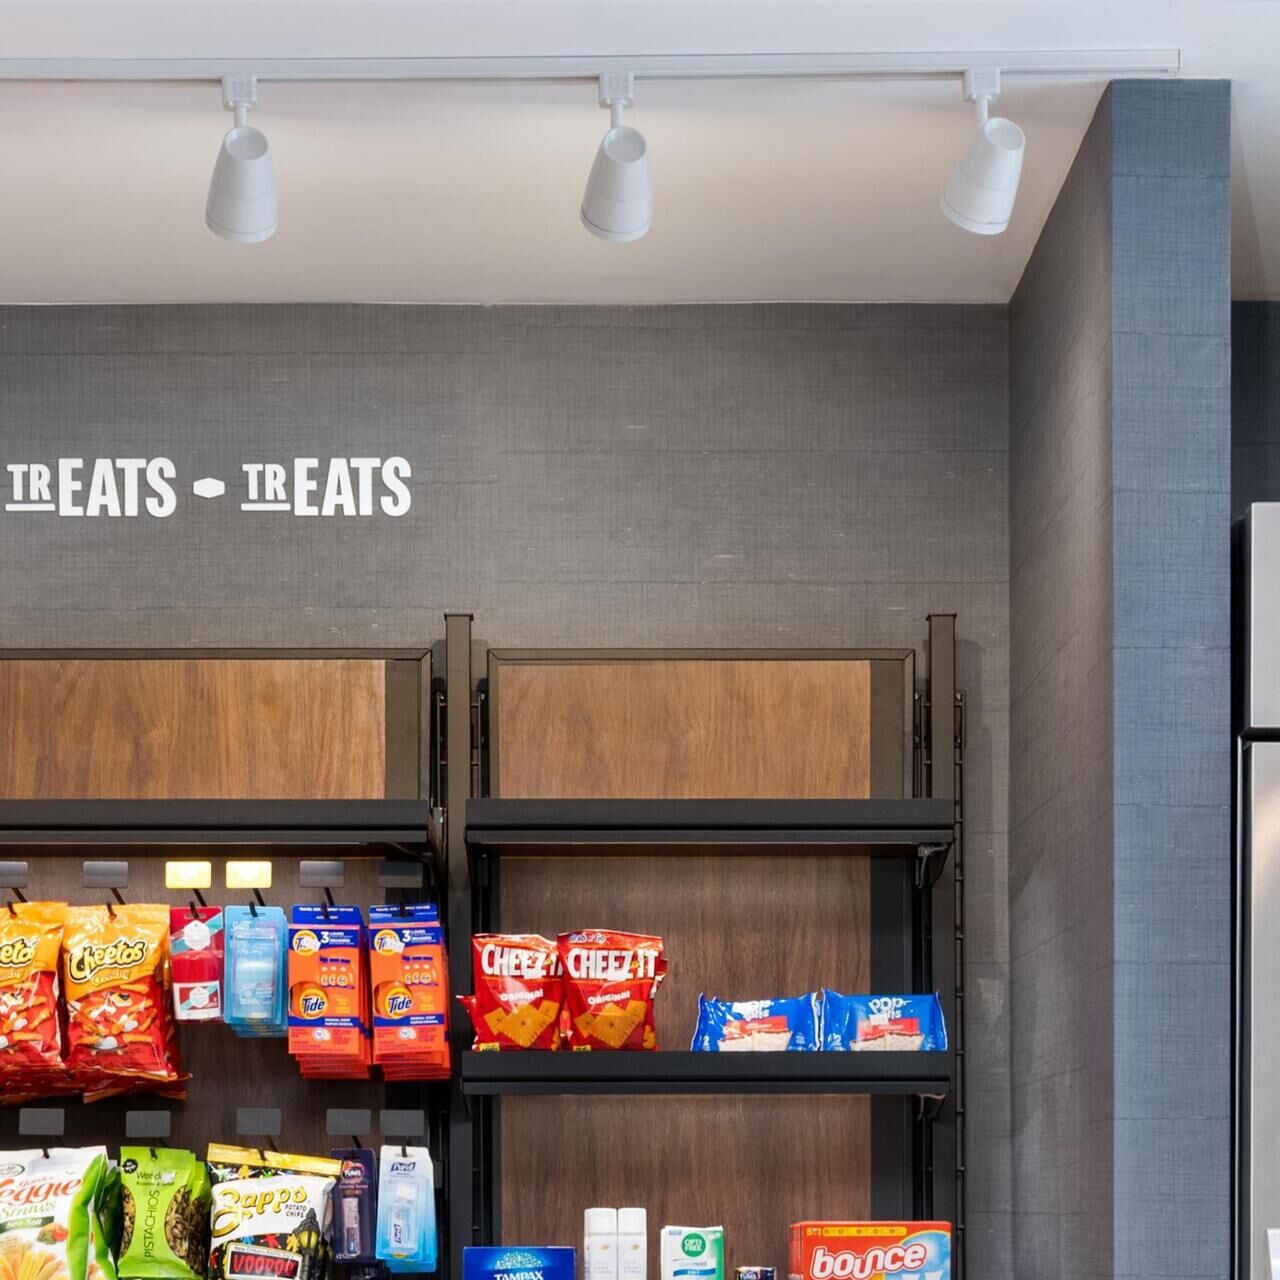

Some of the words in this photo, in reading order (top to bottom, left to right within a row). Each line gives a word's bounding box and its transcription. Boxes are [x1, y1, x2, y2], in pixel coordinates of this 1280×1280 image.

[7, 457, 176, 517] TREATS
[241, 457, 411, 517] TREATS
[321, 931, 329, 943] 3
[402, 930, 410, 942] 3
[69, 938, 146, 984] Cheetos
[302, 998, 325, 1013] Tide
[388, 996, 412, 1013] Tide
[212, 1186, 307, 1238] Zapp's
[285, 1204, 307, 1212] POTATO
[144, 1190, 160, 1258] PISTACHIOS
[812, 1243, 927, 1280] bounce
